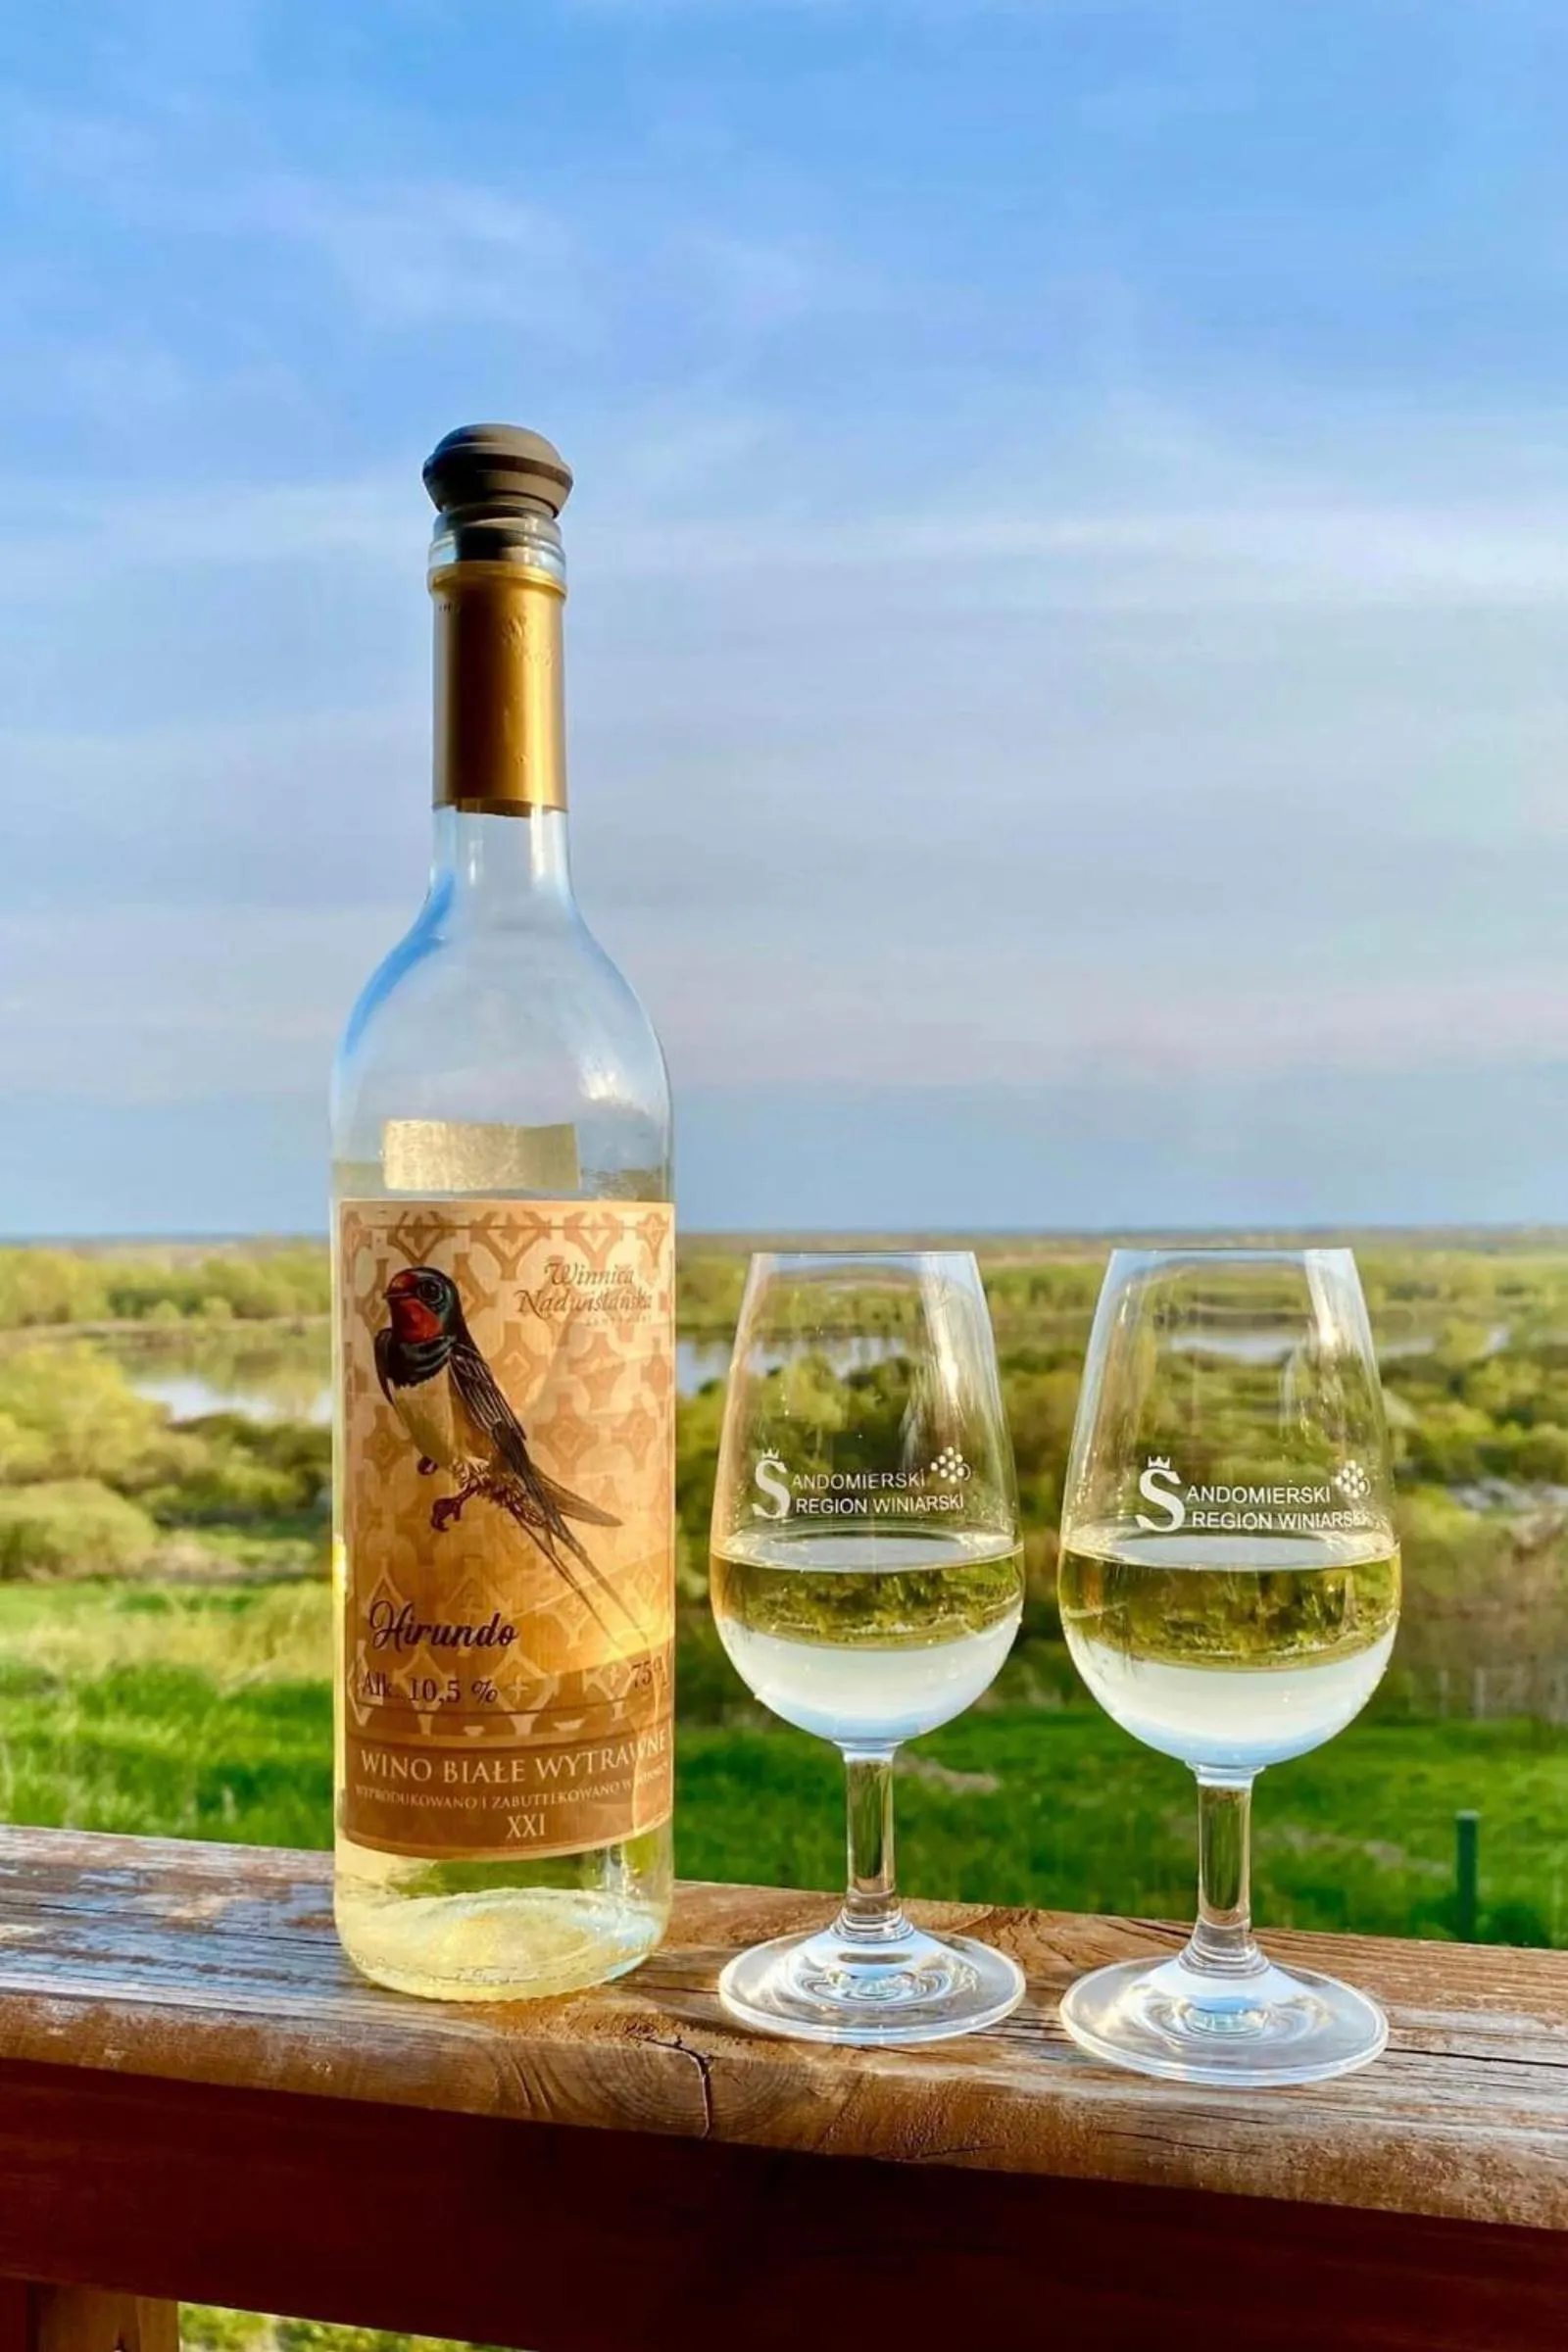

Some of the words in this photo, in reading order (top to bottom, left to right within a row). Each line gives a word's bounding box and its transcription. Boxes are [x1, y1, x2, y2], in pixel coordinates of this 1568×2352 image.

[795, 1497, 868, 1514] REGION
[871, 1494, 964, 1514] WINIARSKI
[1191, 1512, 1273, 1530] REGION
[369, 1599, 519, 1652] Hirundo
[409, 1678, 462, 1705] 10,5
[471, 1679, 498, 1705] %
[361, 1748, 432, 1783] WINO
[444, 1760, 526, 1784] BIAŁE
[535, 1729, 666, 1781] WYTRAWNE
[492, 1780, 619, 1810] ZABUTELKOWANO
[506, 1813, 546, 1839] XXI
